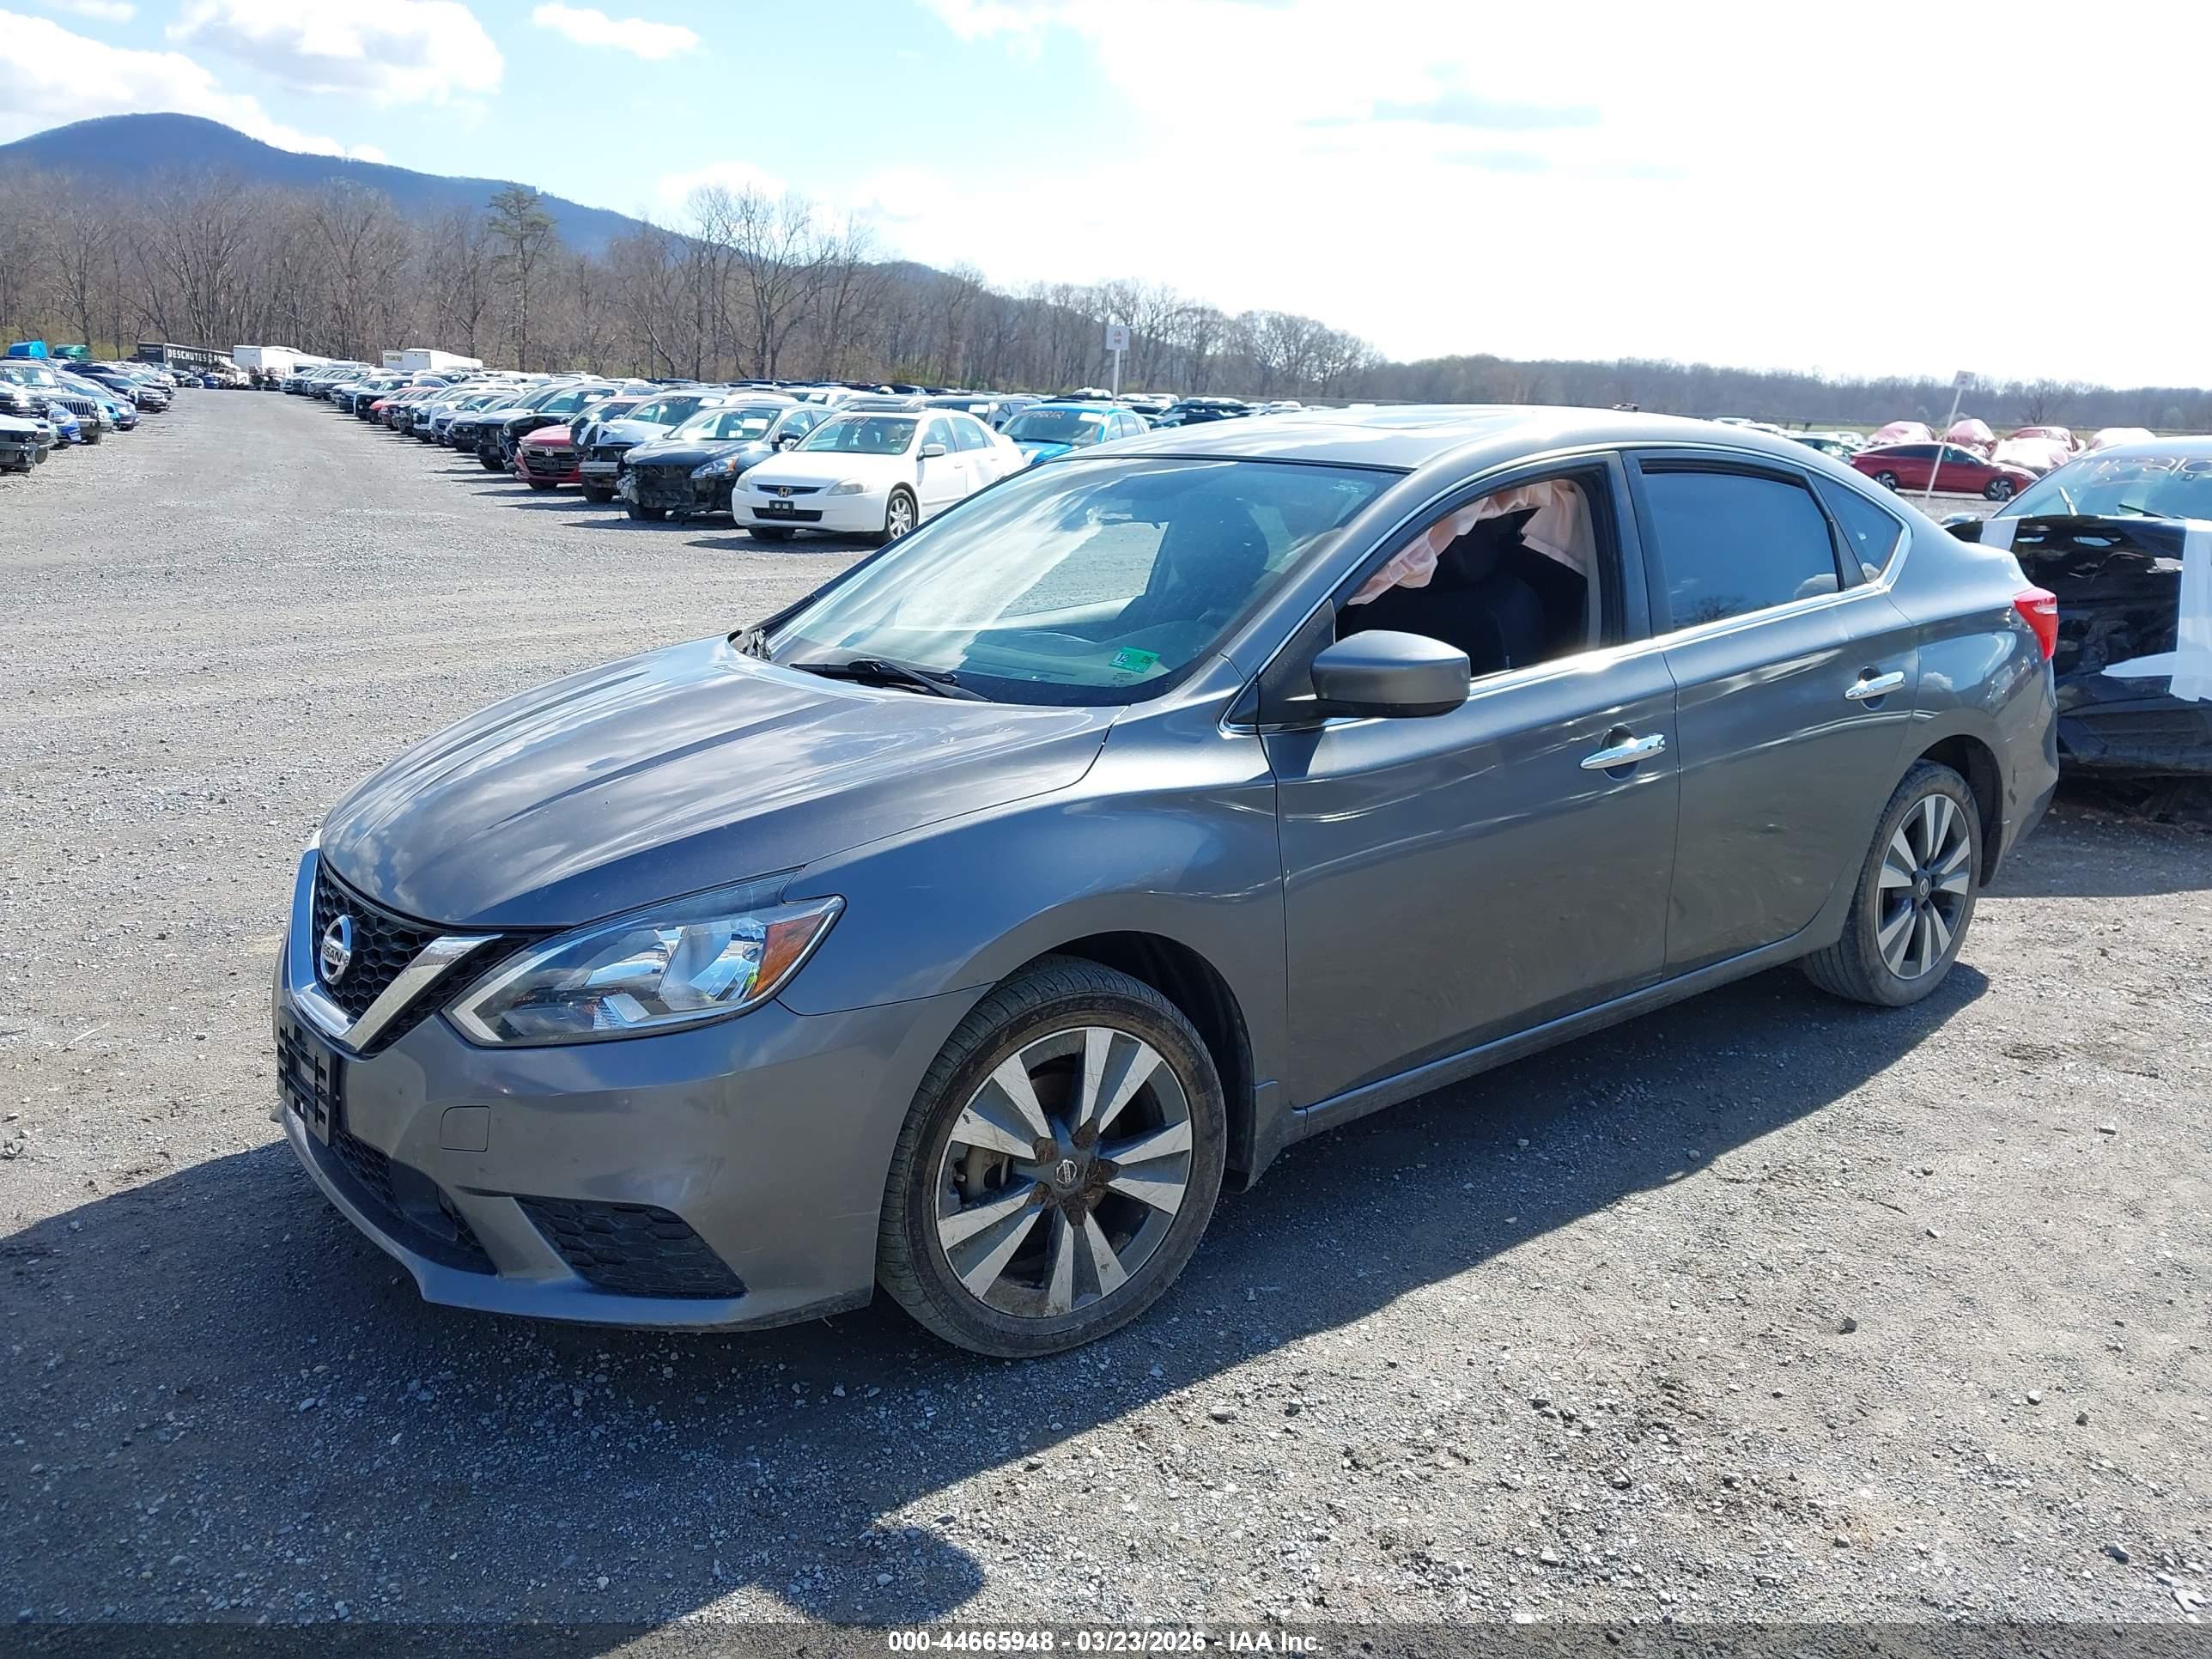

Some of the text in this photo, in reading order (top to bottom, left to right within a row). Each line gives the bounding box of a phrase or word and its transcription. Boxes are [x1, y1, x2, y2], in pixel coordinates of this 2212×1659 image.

[167, 349, 207, 362] DESCHUTES
[1117, 653, 1154, 664] 12 26
